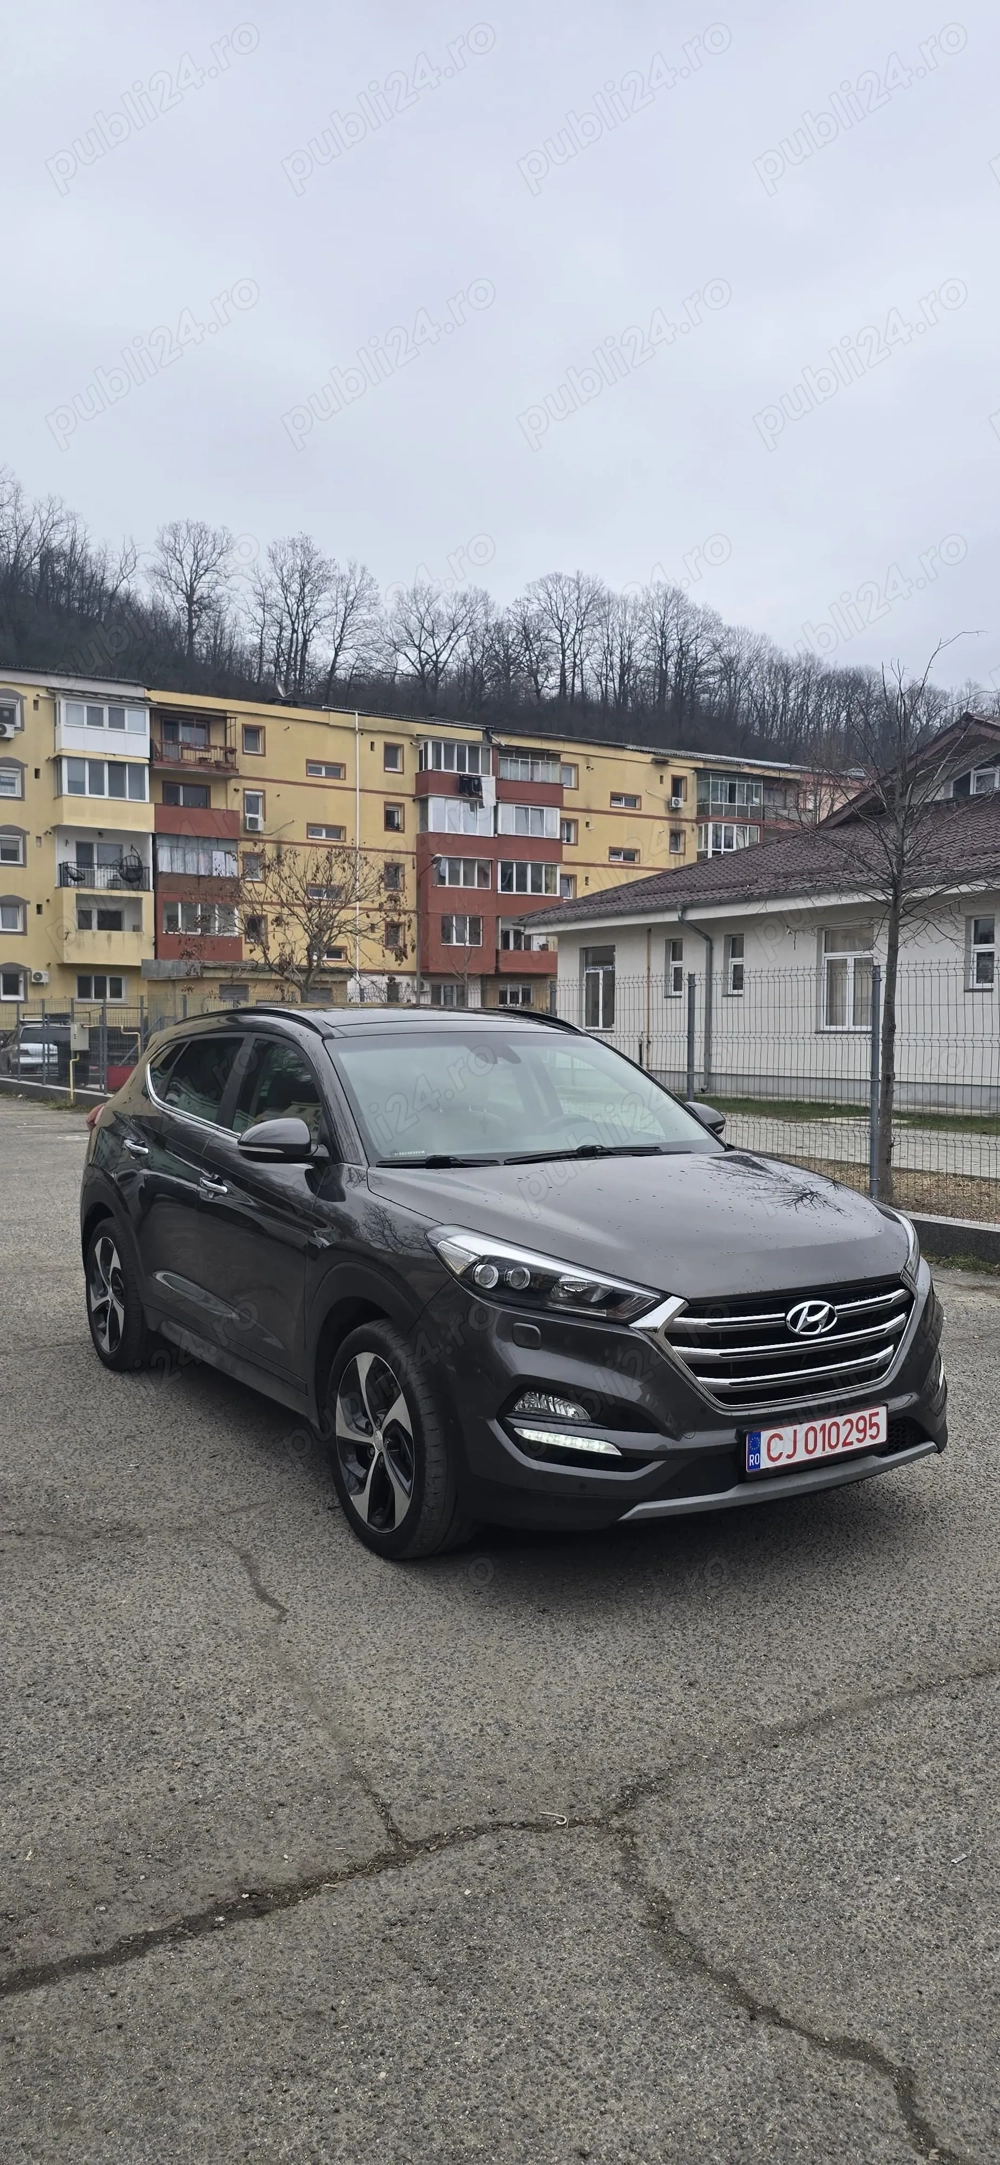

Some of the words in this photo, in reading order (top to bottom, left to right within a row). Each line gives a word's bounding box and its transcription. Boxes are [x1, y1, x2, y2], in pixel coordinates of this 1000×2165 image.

[766, 1429, 798, 1463] CJ
[804, 1411, 881, 1455] 010295
[749, 1453, 760, 1467] RO
